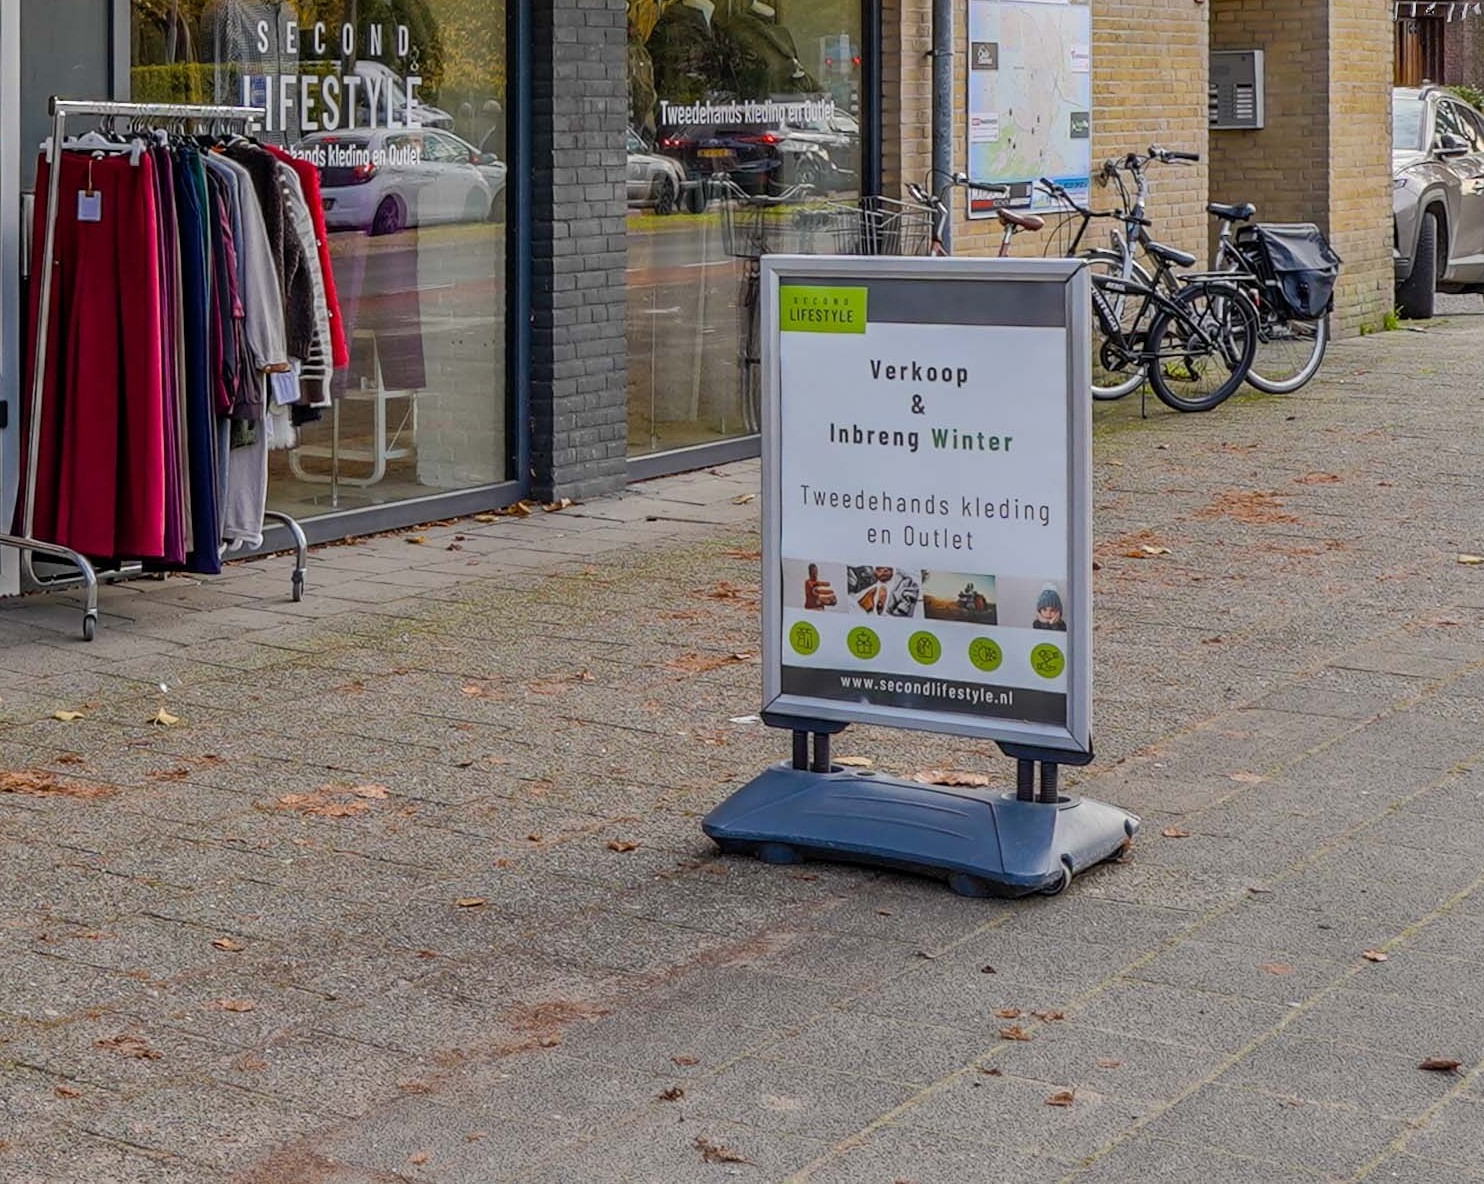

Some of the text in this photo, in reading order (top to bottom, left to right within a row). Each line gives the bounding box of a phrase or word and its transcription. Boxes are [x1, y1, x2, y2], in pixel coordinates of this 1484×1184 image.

[256, 21, 410, 58] SECOND
[242, 74, 423, 132] LIFESTYLE
[660, 100, 743, 125] Tweedehands
[744, 99, 786, 124] kleding
[328, 144, 371, 168] kleding
[373, 152, 387, 167] en
[793, 296, 849, 305] SECOND
[790, 308, 854, 323] LIFESTYLE
[870, 359, 970, 387] Verkoop
[911, 394, 927, 416] &
[829, 422, 1015, 453] Inbreng Winter
[800, 483, 1051, 527] Tweedehands kleding
[867, 526, 975, 552] en Outlet
[840, 675, 1015, 706] www.secondlifestyle.nl
